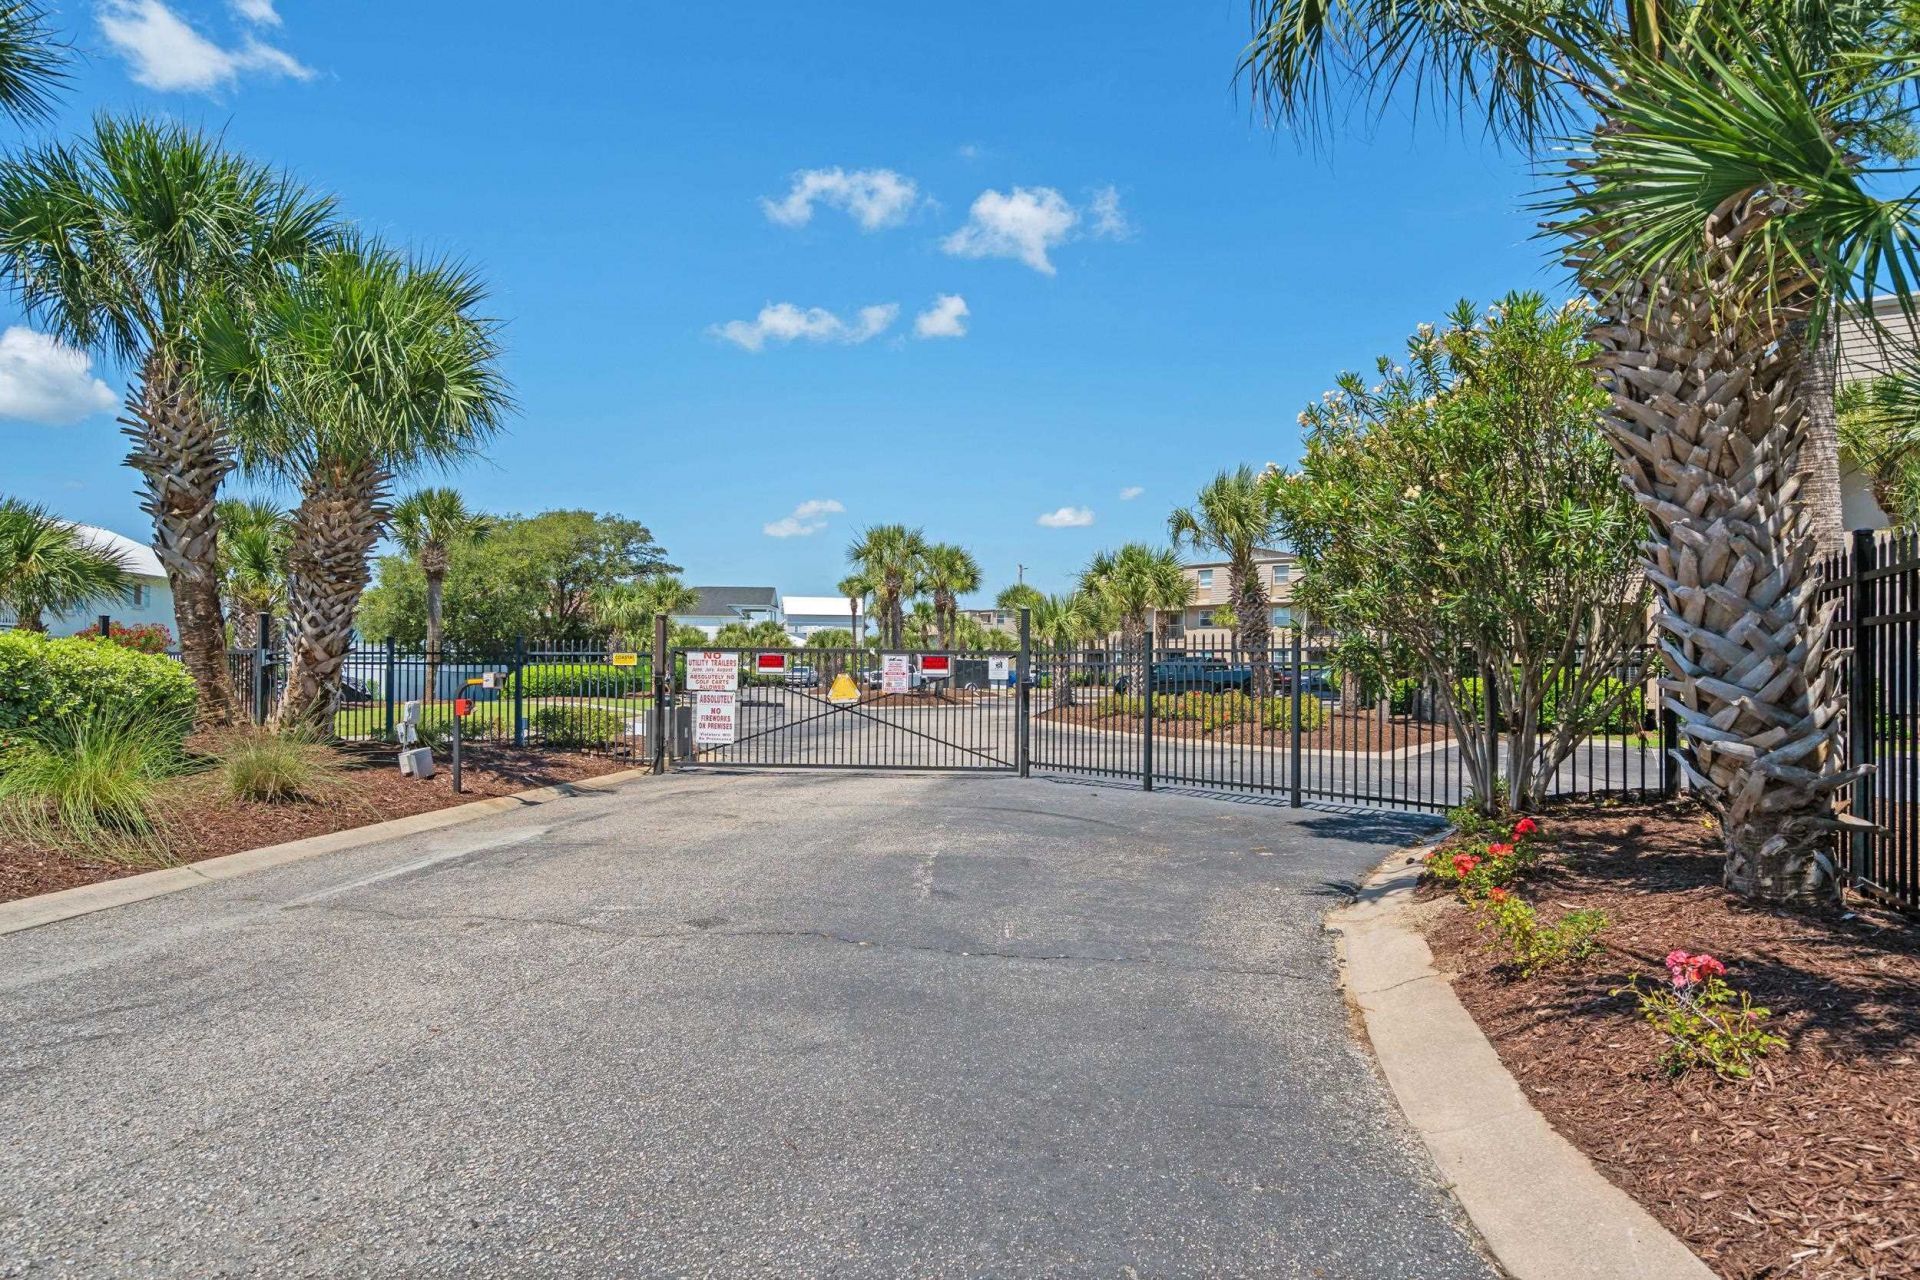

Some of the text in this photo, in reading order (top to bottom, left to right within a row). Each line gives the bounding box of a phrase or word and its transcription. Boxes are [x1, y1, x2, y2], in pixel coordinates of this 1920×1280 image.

[703, 651, 721, 659] NO
[699, 694, 733, 704] ABSOLUTELY
[708, 722, 732, 730] PREMISES
